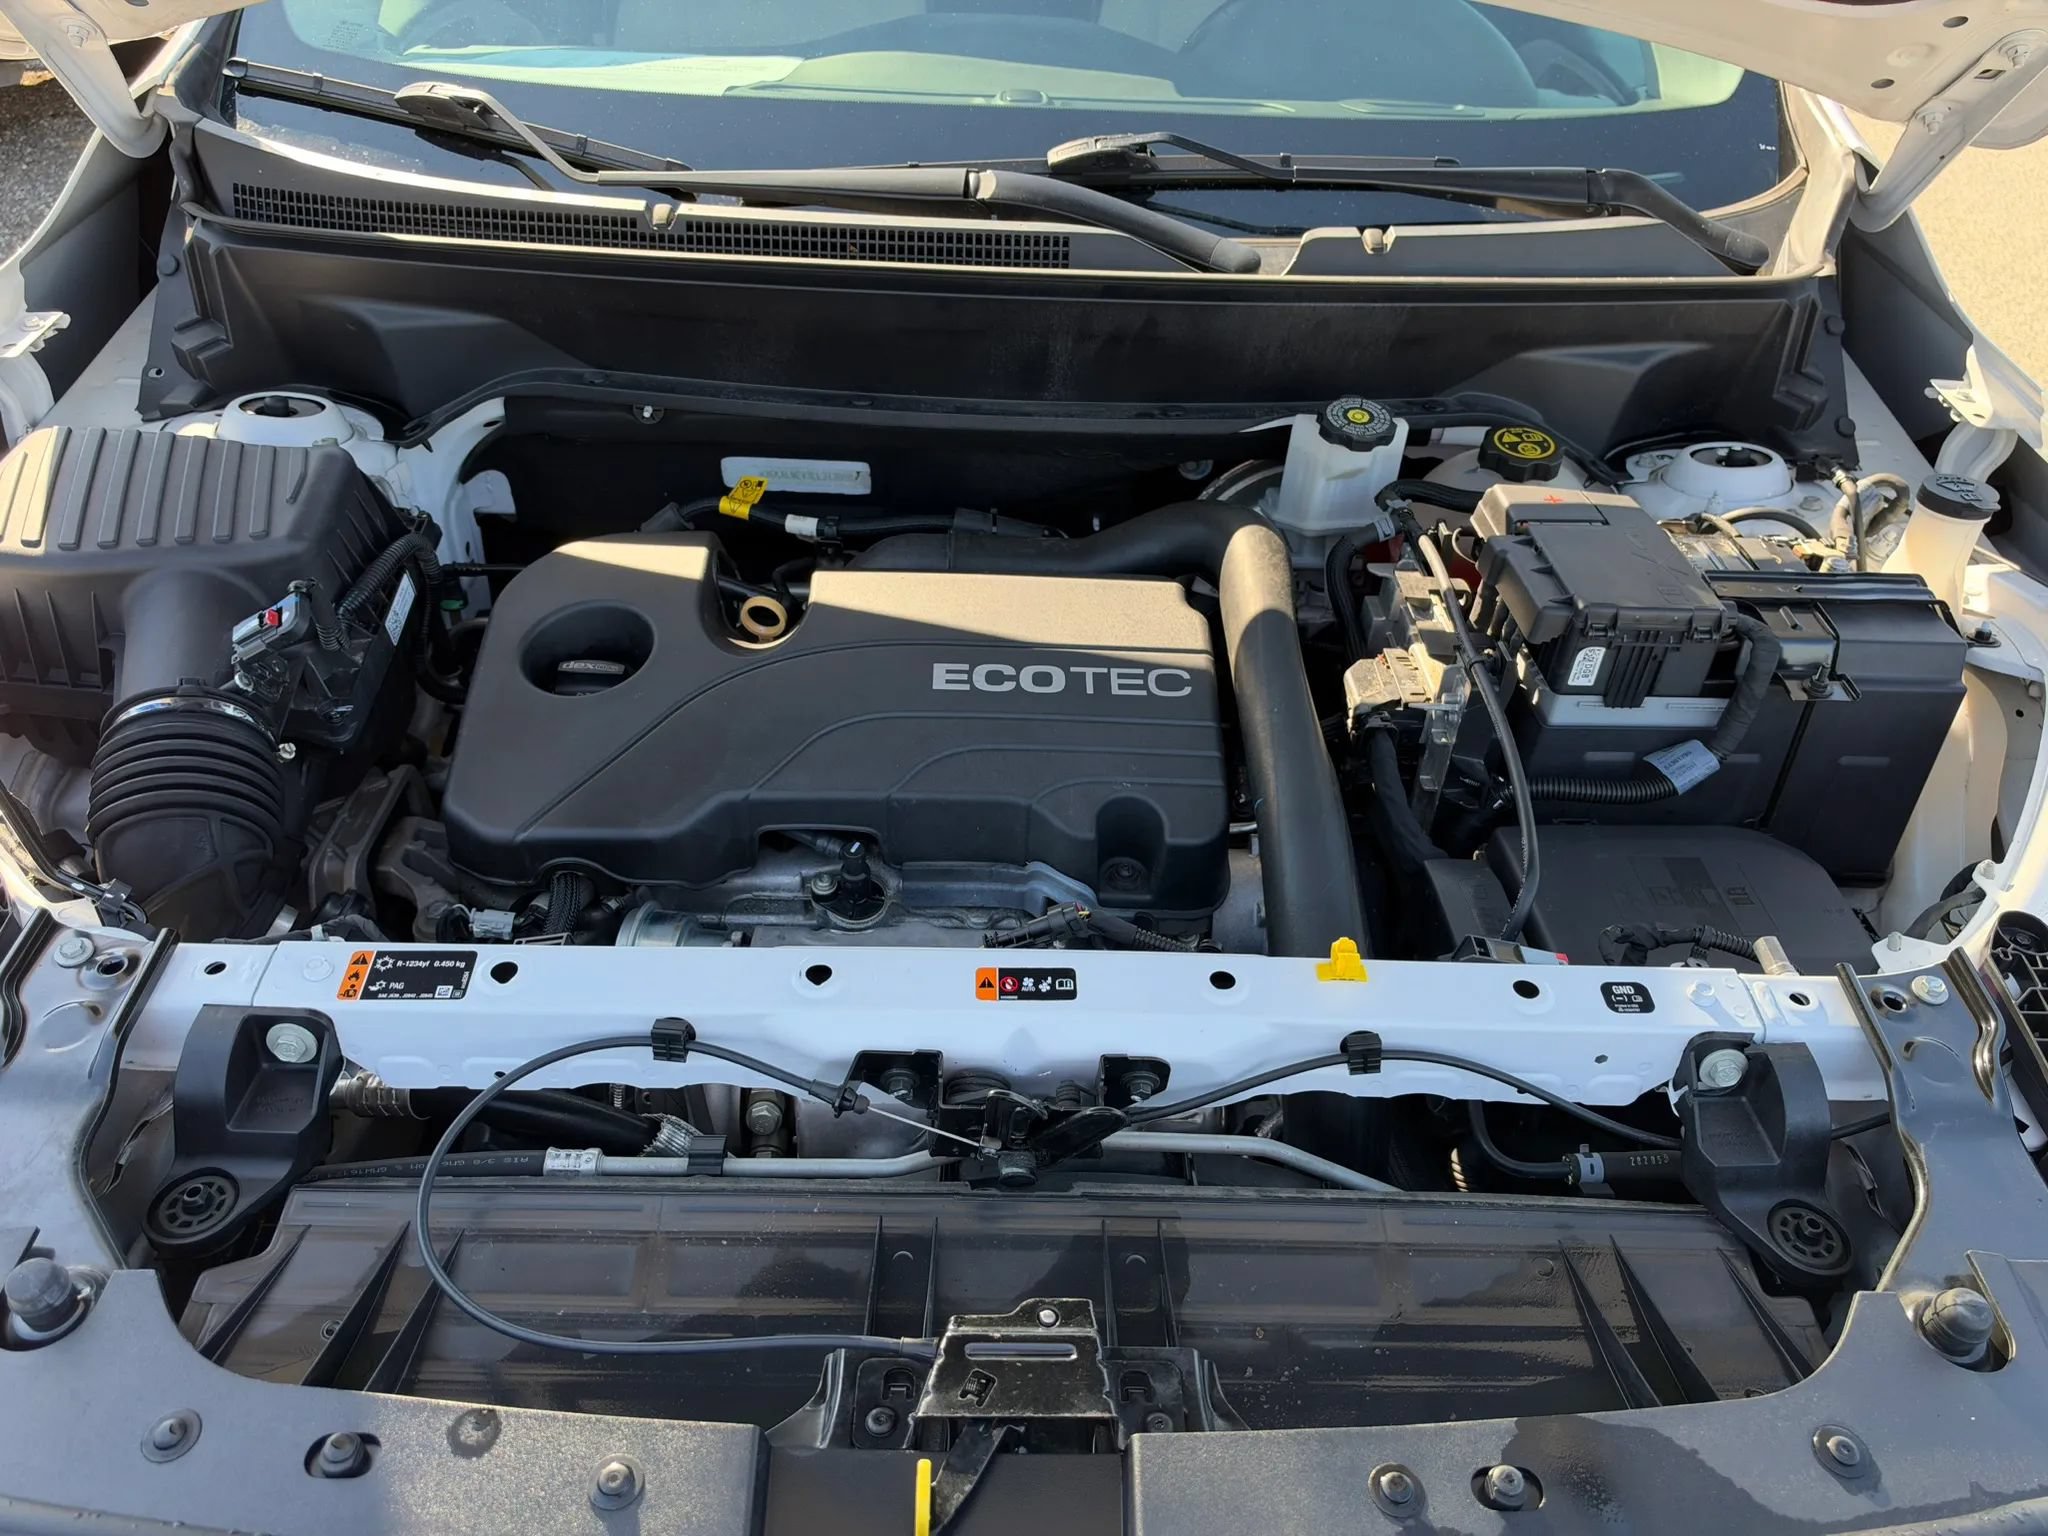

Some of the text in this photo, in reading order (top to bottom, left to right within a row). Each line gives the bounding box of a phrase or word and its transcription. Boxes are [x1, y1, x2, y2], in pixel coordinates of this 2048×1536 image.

[932, 662, 1192, 697] ECOTEC
[396, 960, 466, 969] R-1234yf 0.450 kg
[388, 982, 405, 990] PAG
[1612, 985, 1635, 994] GND
